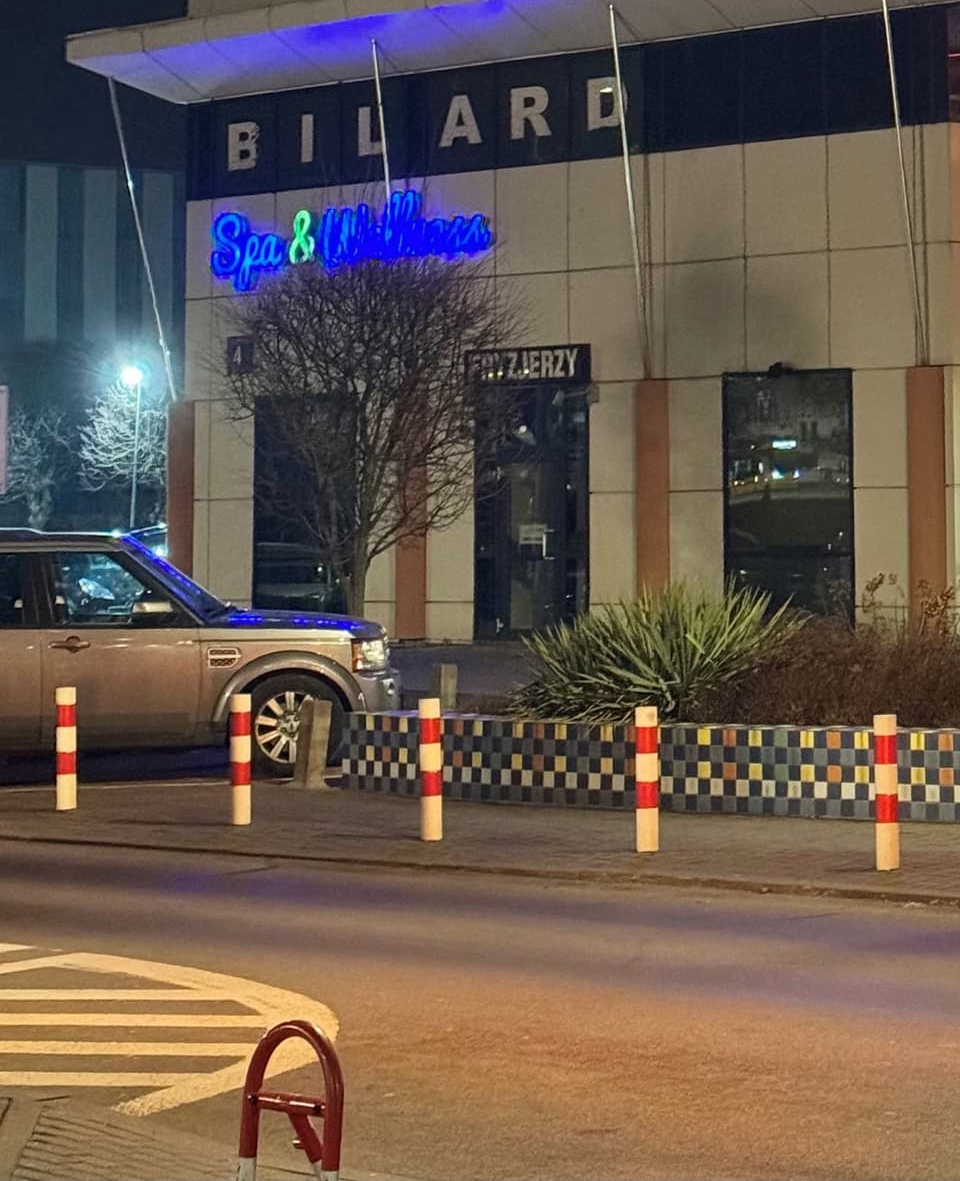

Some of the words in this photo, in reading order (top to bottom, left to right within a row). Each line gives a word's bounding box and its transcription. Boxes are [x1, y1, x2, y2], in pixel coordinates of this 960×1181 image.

[227, 77, 626, 171] BILARD
[211, 212, 283, 292] Spa
[289, 210, 315, 265] &
